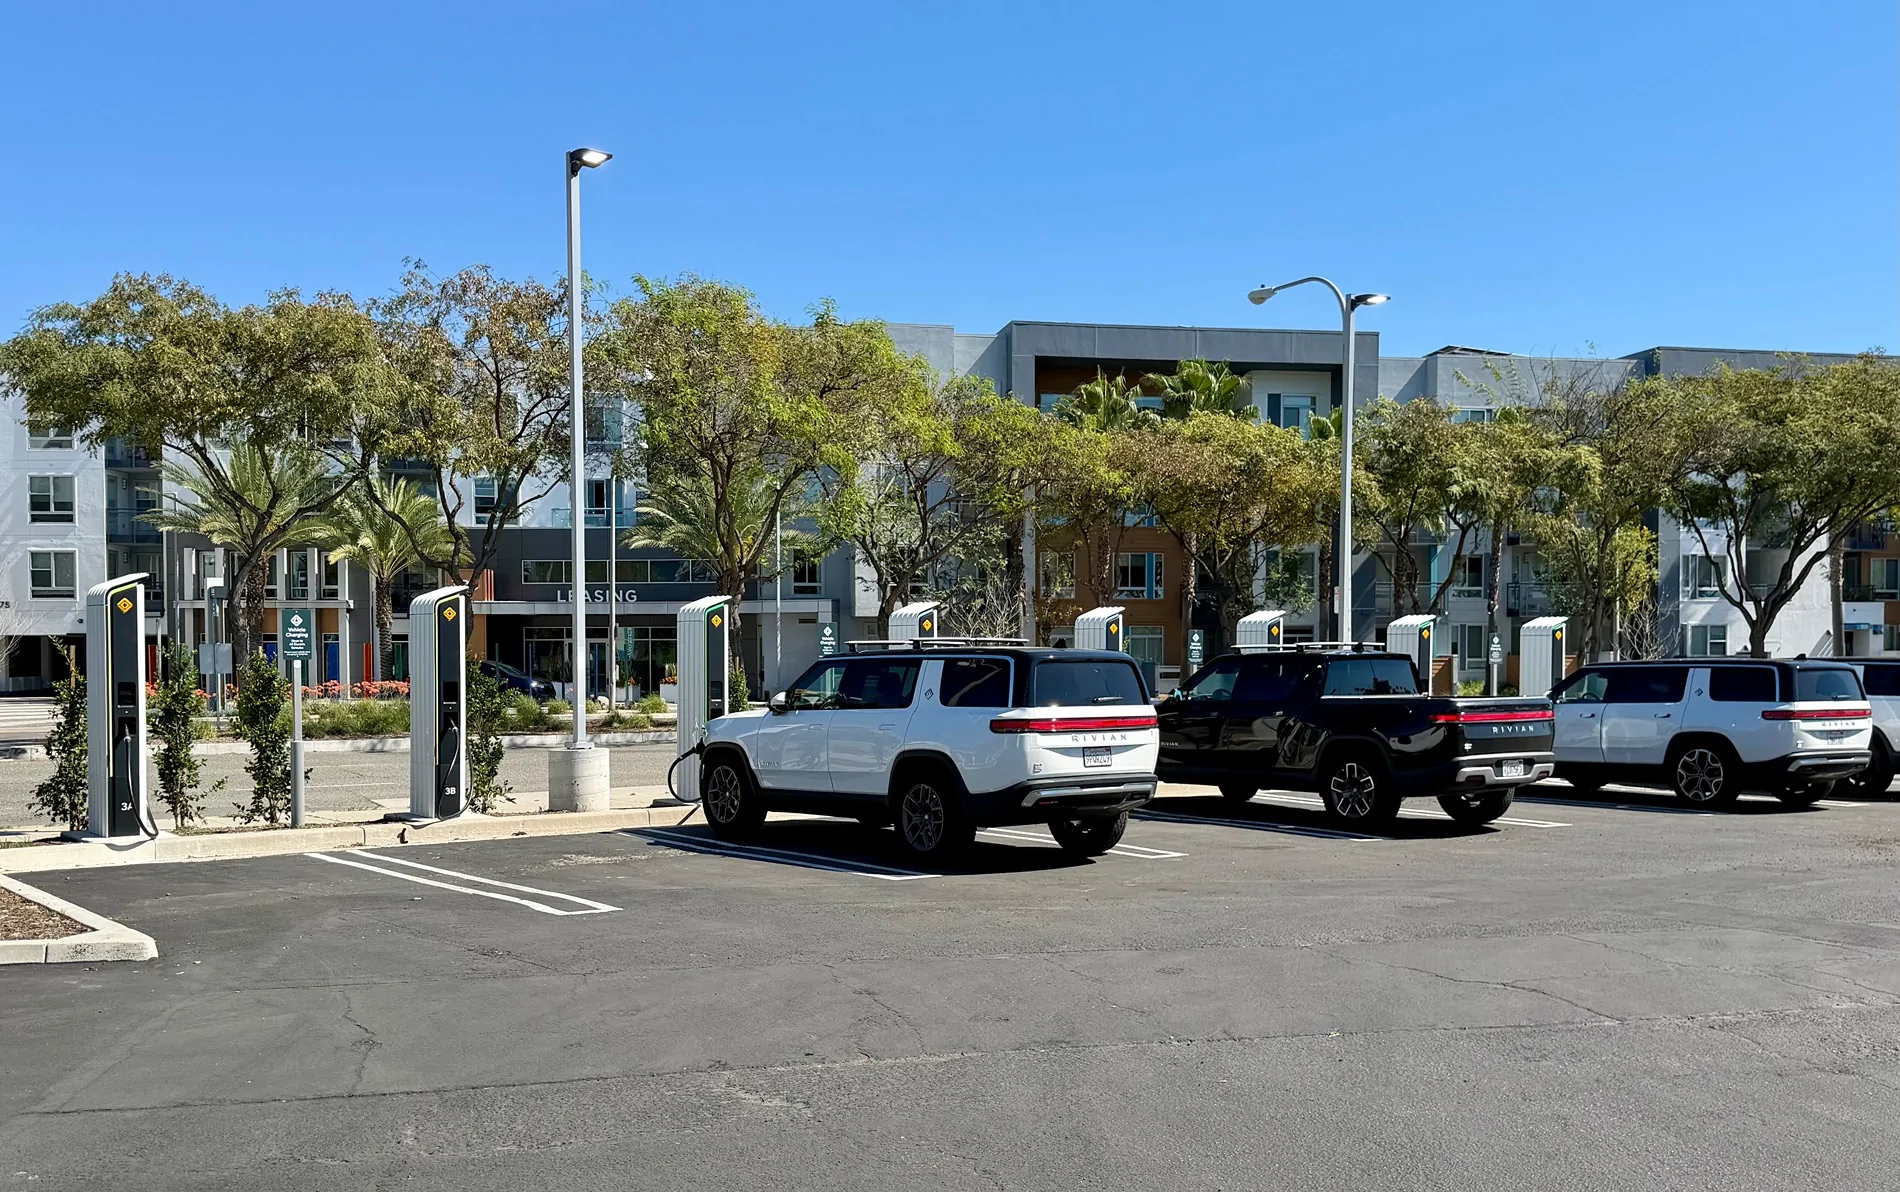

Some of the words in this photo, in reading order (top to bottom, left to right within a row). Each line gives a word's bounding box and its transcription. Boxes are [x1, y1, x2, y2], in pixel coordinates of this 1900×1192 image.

[1492, 725, 1534, 734] RIVIAN
[1071, 733, 1127, 743] RIVIAN
[444, 787, 456, 795] 3B
